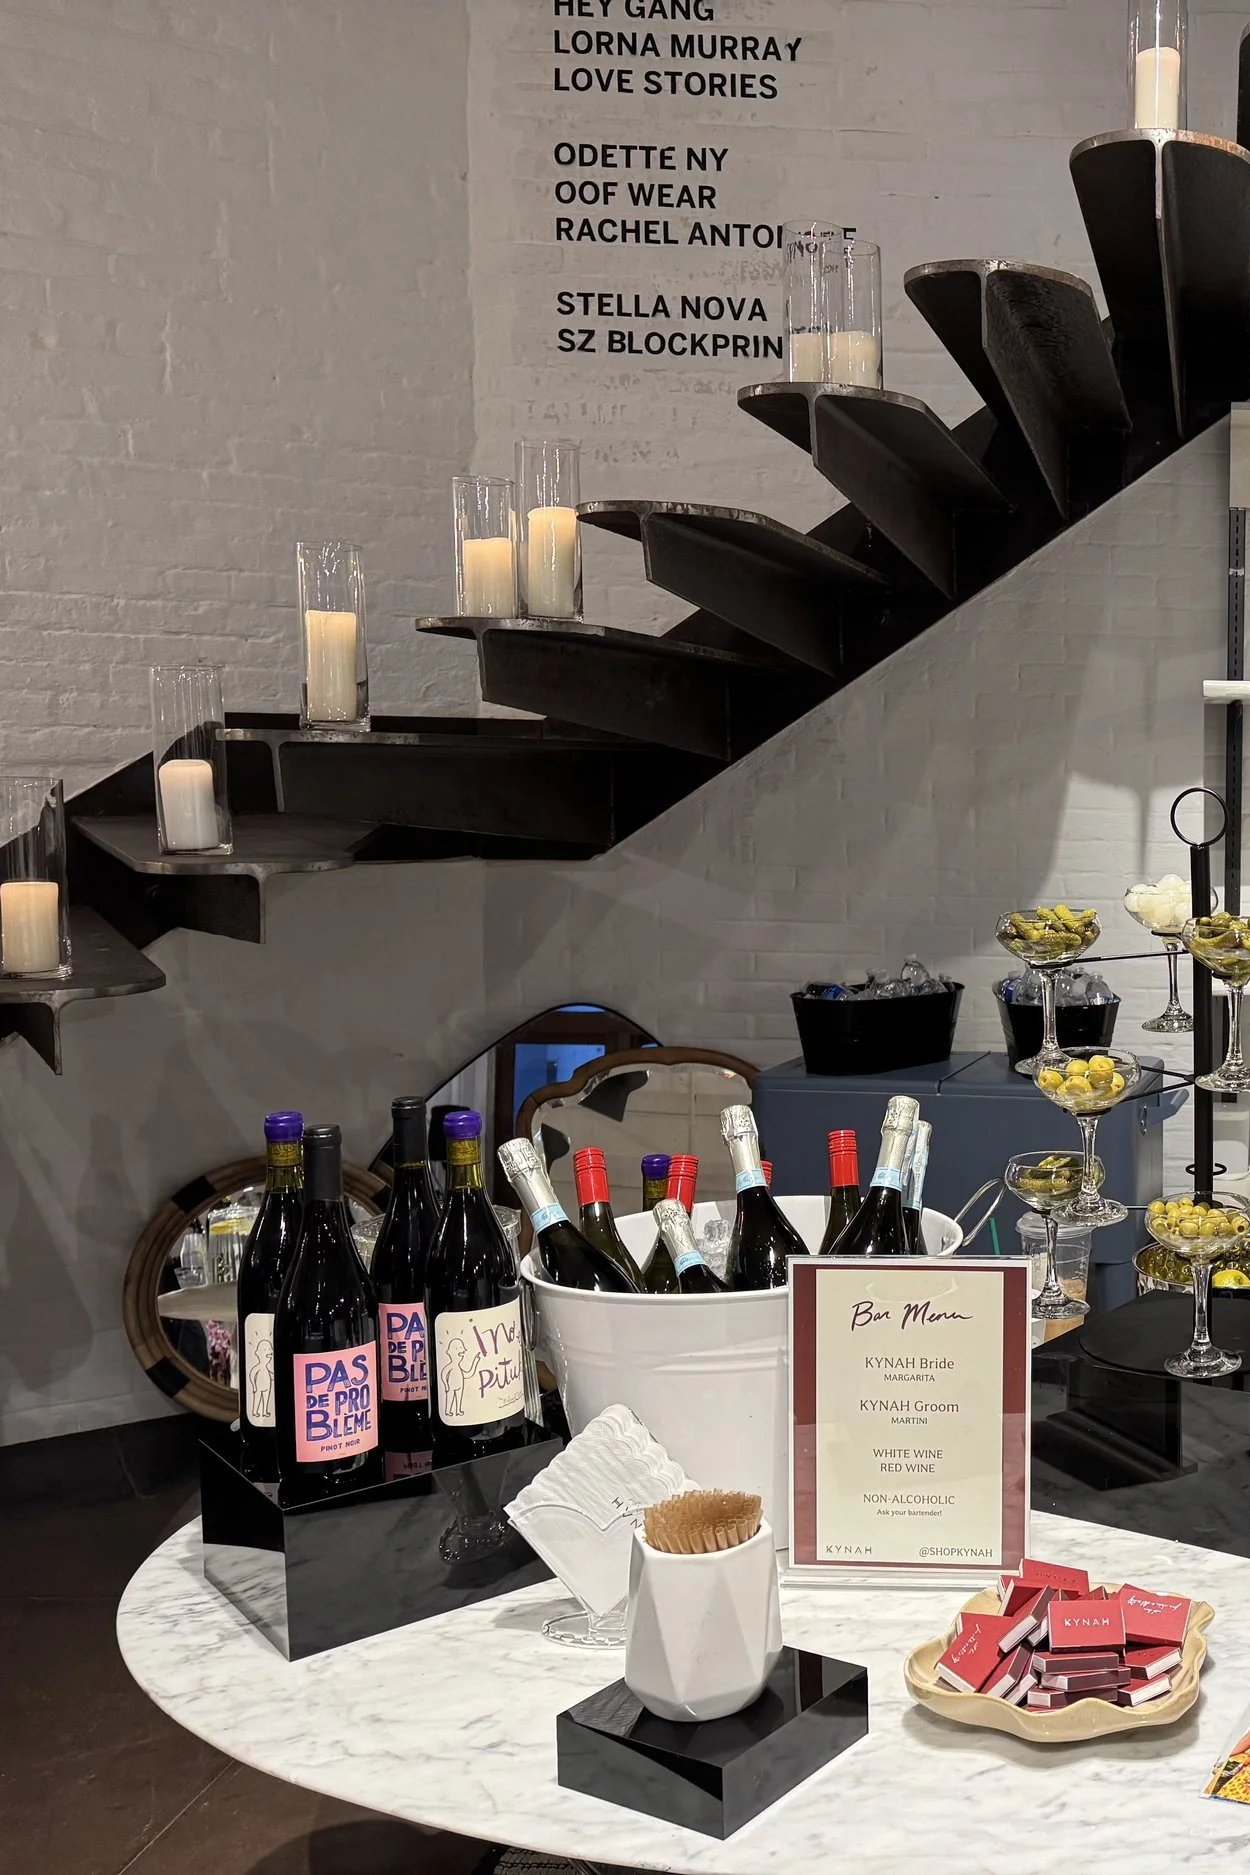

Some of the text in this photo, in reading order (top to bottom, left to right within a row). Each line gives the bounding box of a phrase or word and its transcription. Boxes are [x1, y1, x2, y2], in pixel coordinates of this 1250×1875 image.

[554, 0, 714, 21] HEY GANG
[554, 30, 802, 62] LORNA MURRAY
[554, 68, 777, 99] LOVE STORIES
[554, 143, 728, 171] ODETTE NY
[555, 181, 716, 209] OOF WEAR
[556, 218, 678, 245] RACHEL
[557, 292, 767, 321] STELLA NOVA
[558, 329, 596, 352] SZ
[851, 1301, 973, 1331] Bar Menu
[387, 1312, 425, 1339] PA
[388, 1341, 406, 1354] DE
[865, 1357, 955, 1369] KYNAH Bride
[305, 1355, 369, 1393] PAS
[884, 1374, 935, 1382] MARGARITA
[400, 1385, 419, 1393] PINOT
[306, 1384, 371, 1416] DE PRO
[860, 1400, 959, 1413] KYNAH Groom
[306, 1409, 371, 1441] BLÈME
[891, 1417, 928, 1425] MARTINI
[320, 1438, 361, 1453] PINOT NOIR
[873, 1449, 943, 1459] WHITE WINE
[880, 1463, 935, 1473] RED WINE
[863, 1494, 955, 1505] NON-ALCOHOLIC
[891, 1509, 906, 1517] your
[908, 1509, 942, 1517] bartender!
[826, 1545, 993, 1558] KYNAH @SHOPKYNAH
[1064, 1617, 1110, 1627] KYNAH
